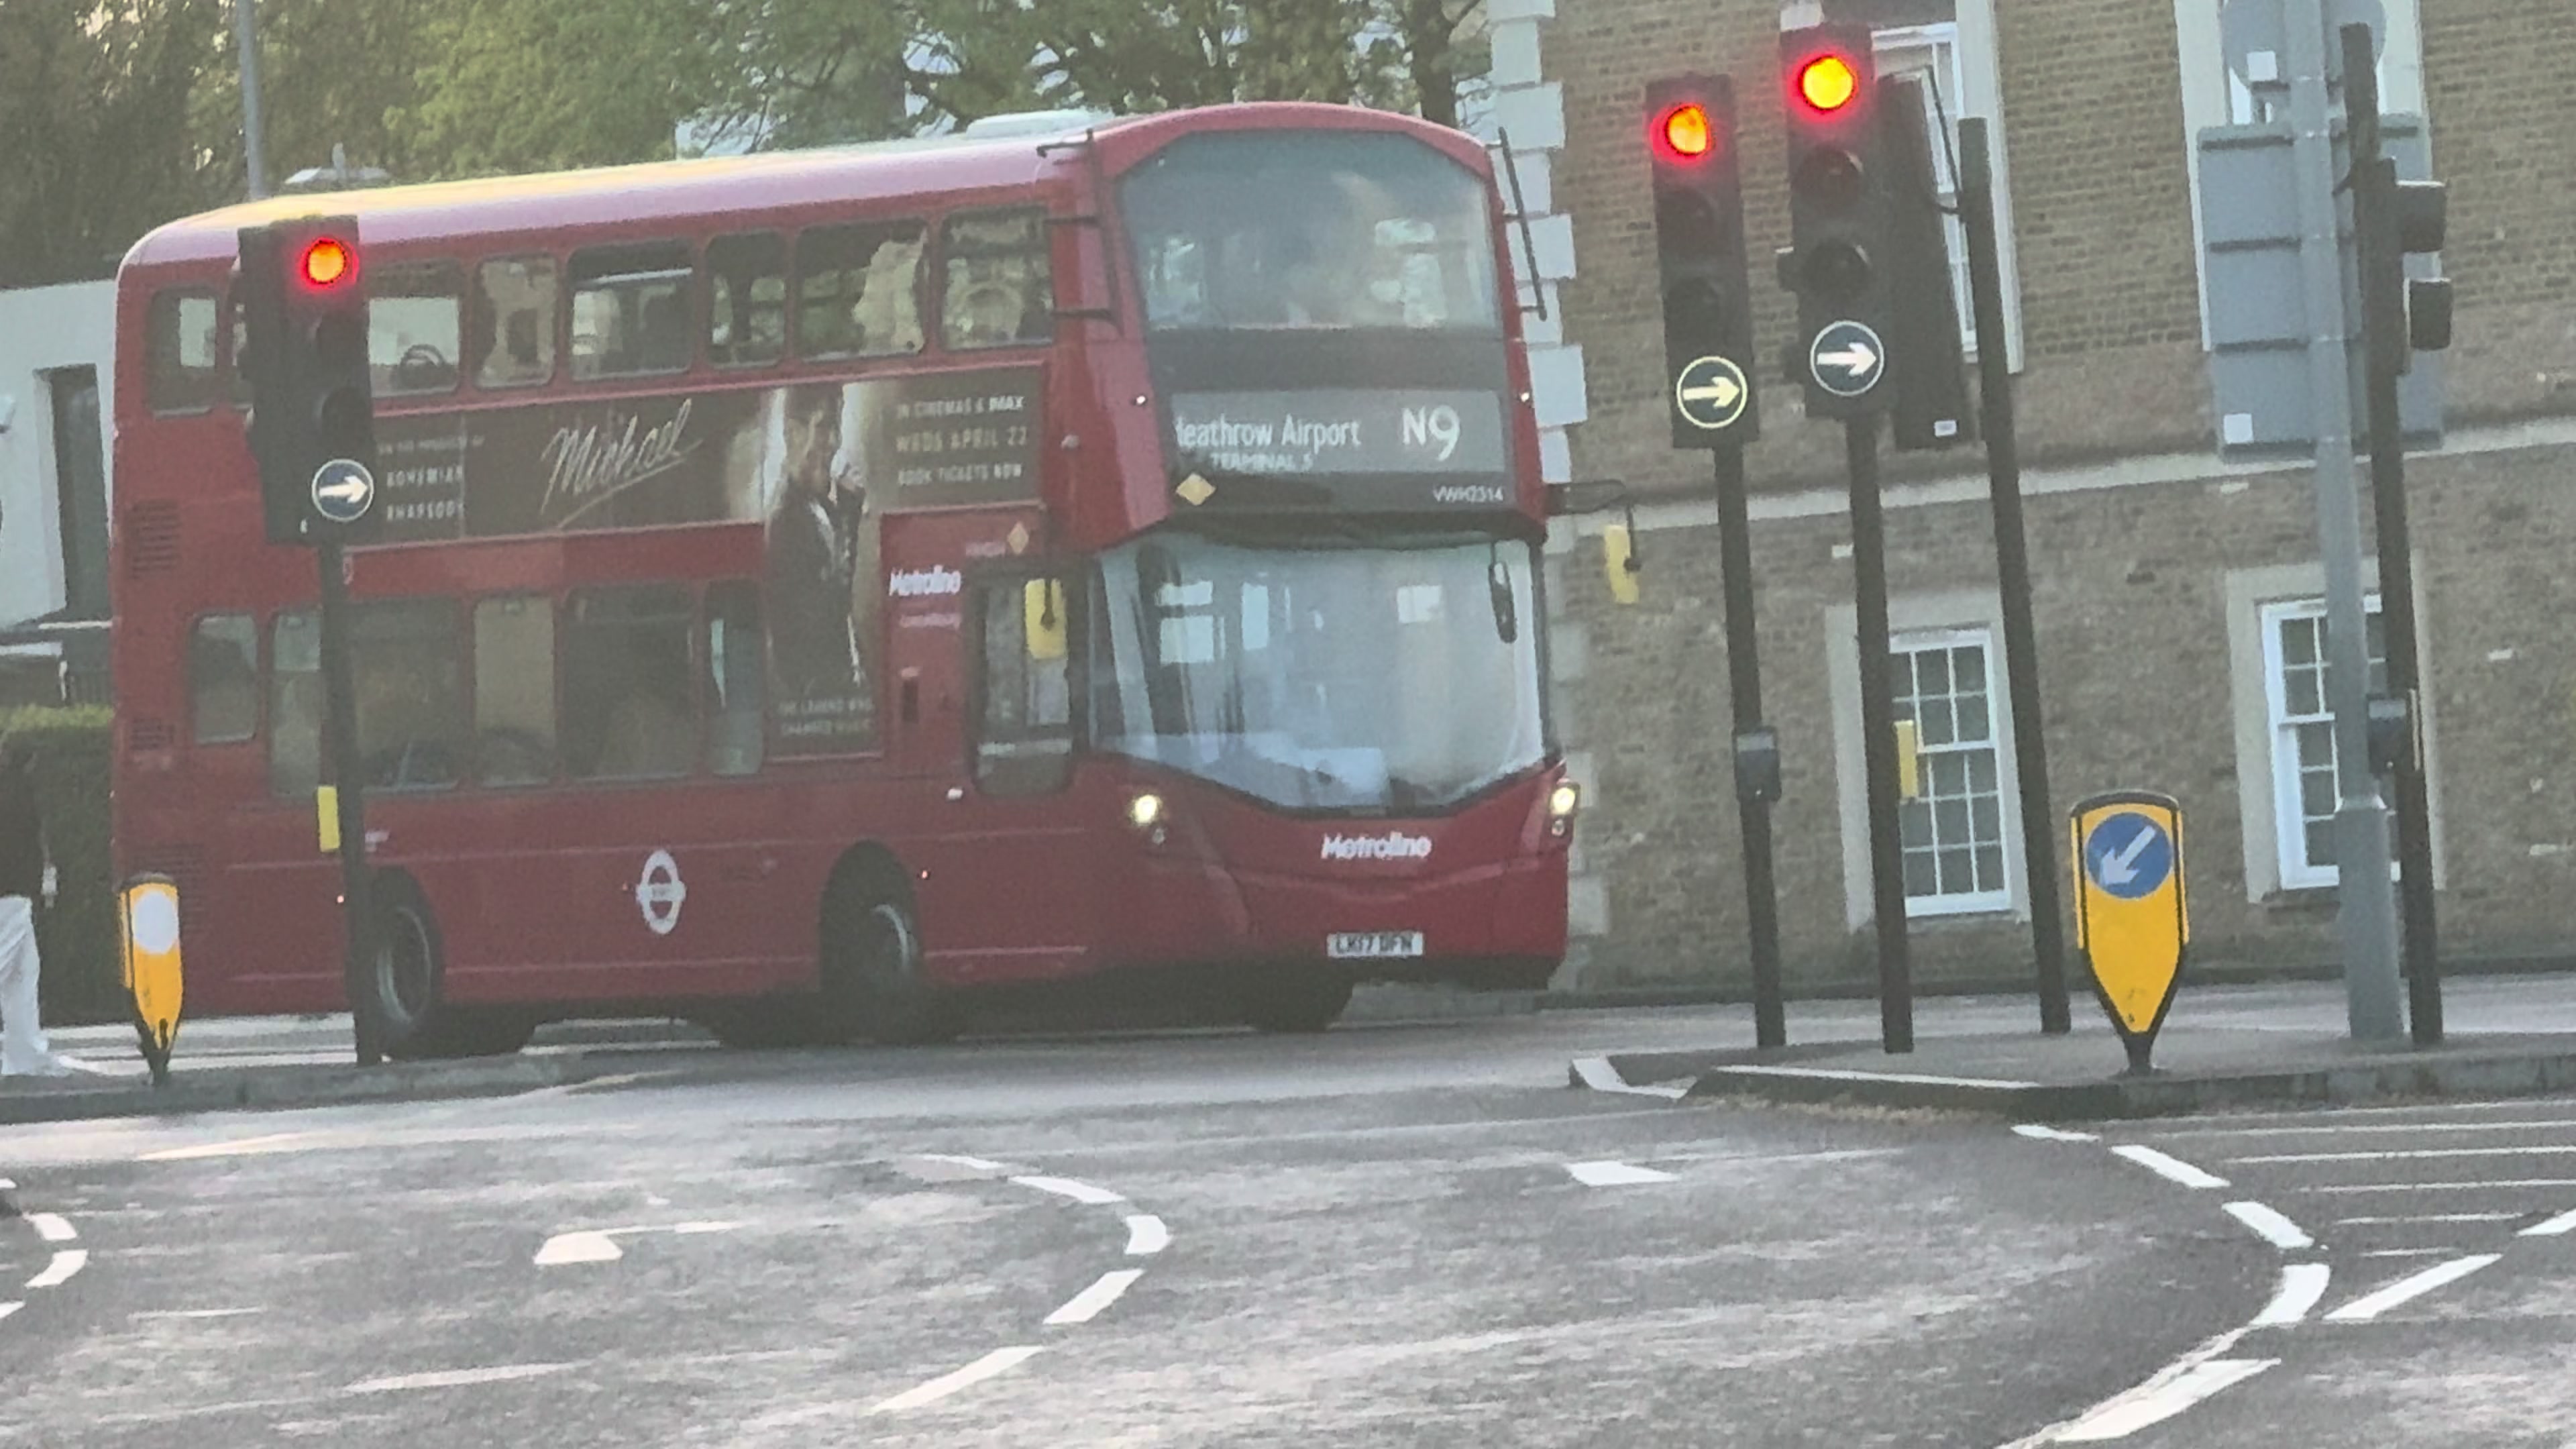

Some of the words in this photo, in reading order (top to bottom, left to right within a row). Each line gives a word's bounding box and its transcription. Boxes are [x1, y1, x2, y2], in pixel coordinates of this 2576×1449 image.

[950, 427, 998, 449] APRIL
[1281, 413, 1362, 455] Airport
[1401, 404, 1461, 462] N9
[1320, 830, 1433, 859] Metroline
